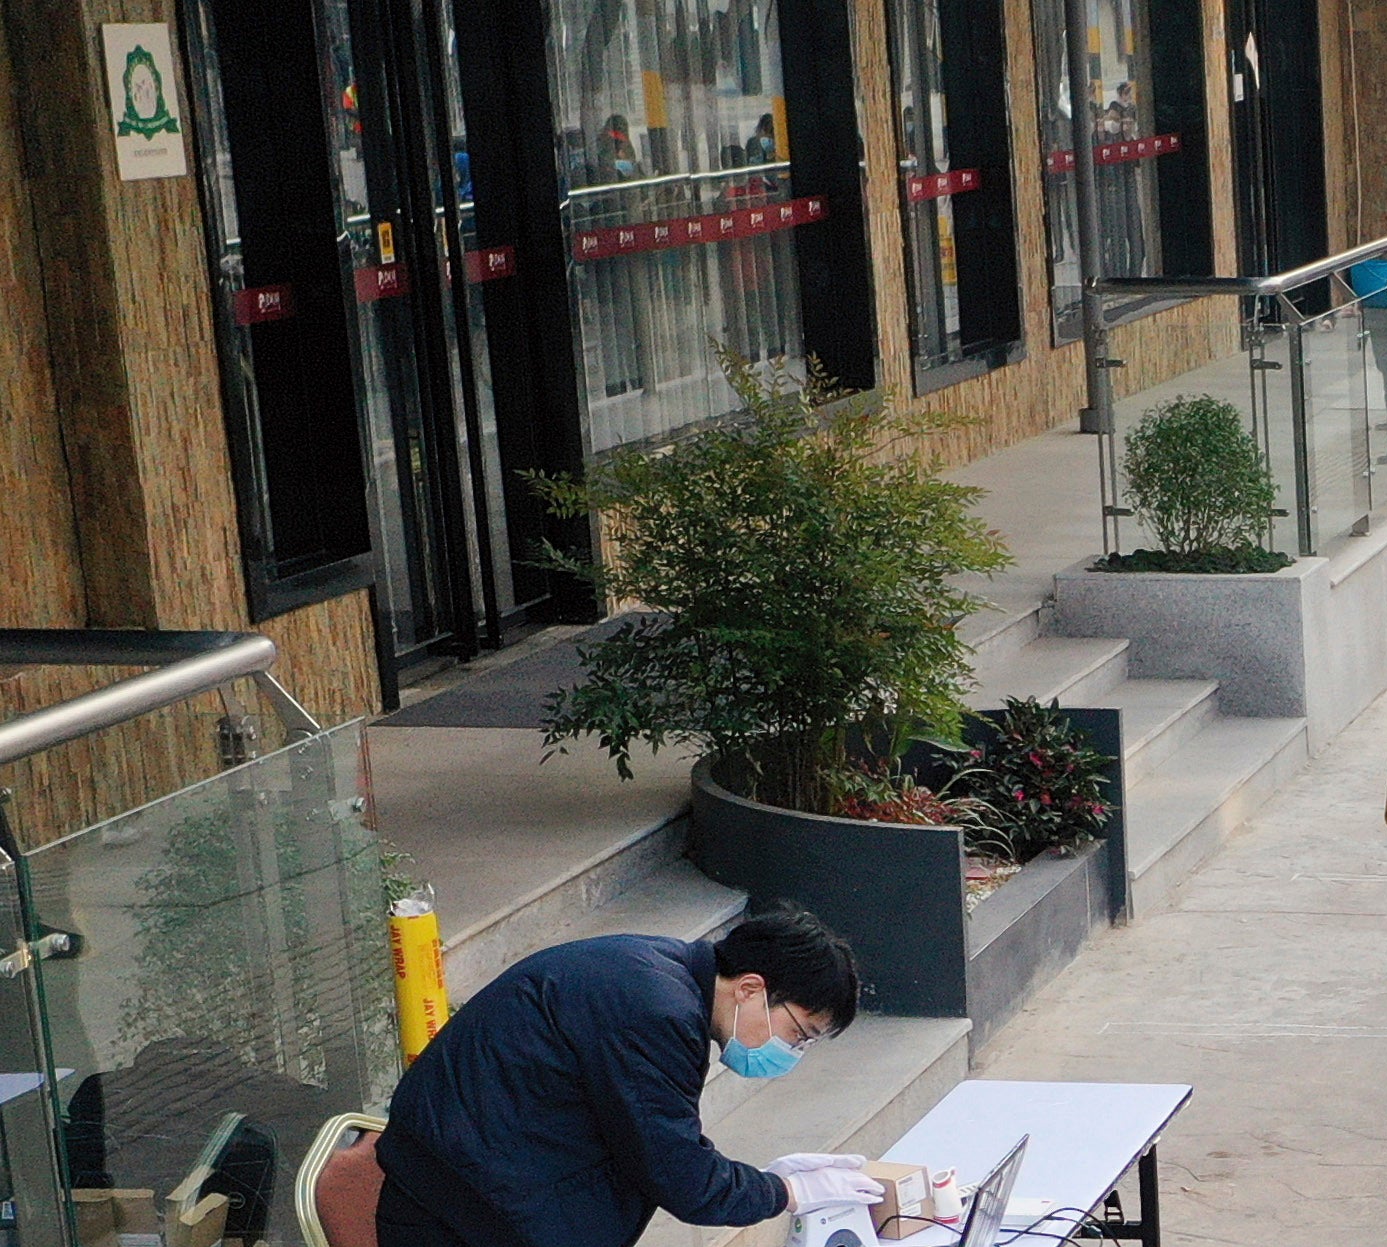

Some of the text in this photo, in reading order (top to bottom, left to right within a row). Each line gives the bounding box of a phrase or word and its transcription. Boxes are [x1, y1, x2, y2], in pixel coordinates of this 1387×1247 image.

[390, 924, 406, 980] JAY WRAP
[423, 998, 436, 1017] JAY
[425, 1019, 437, 1040] WR
